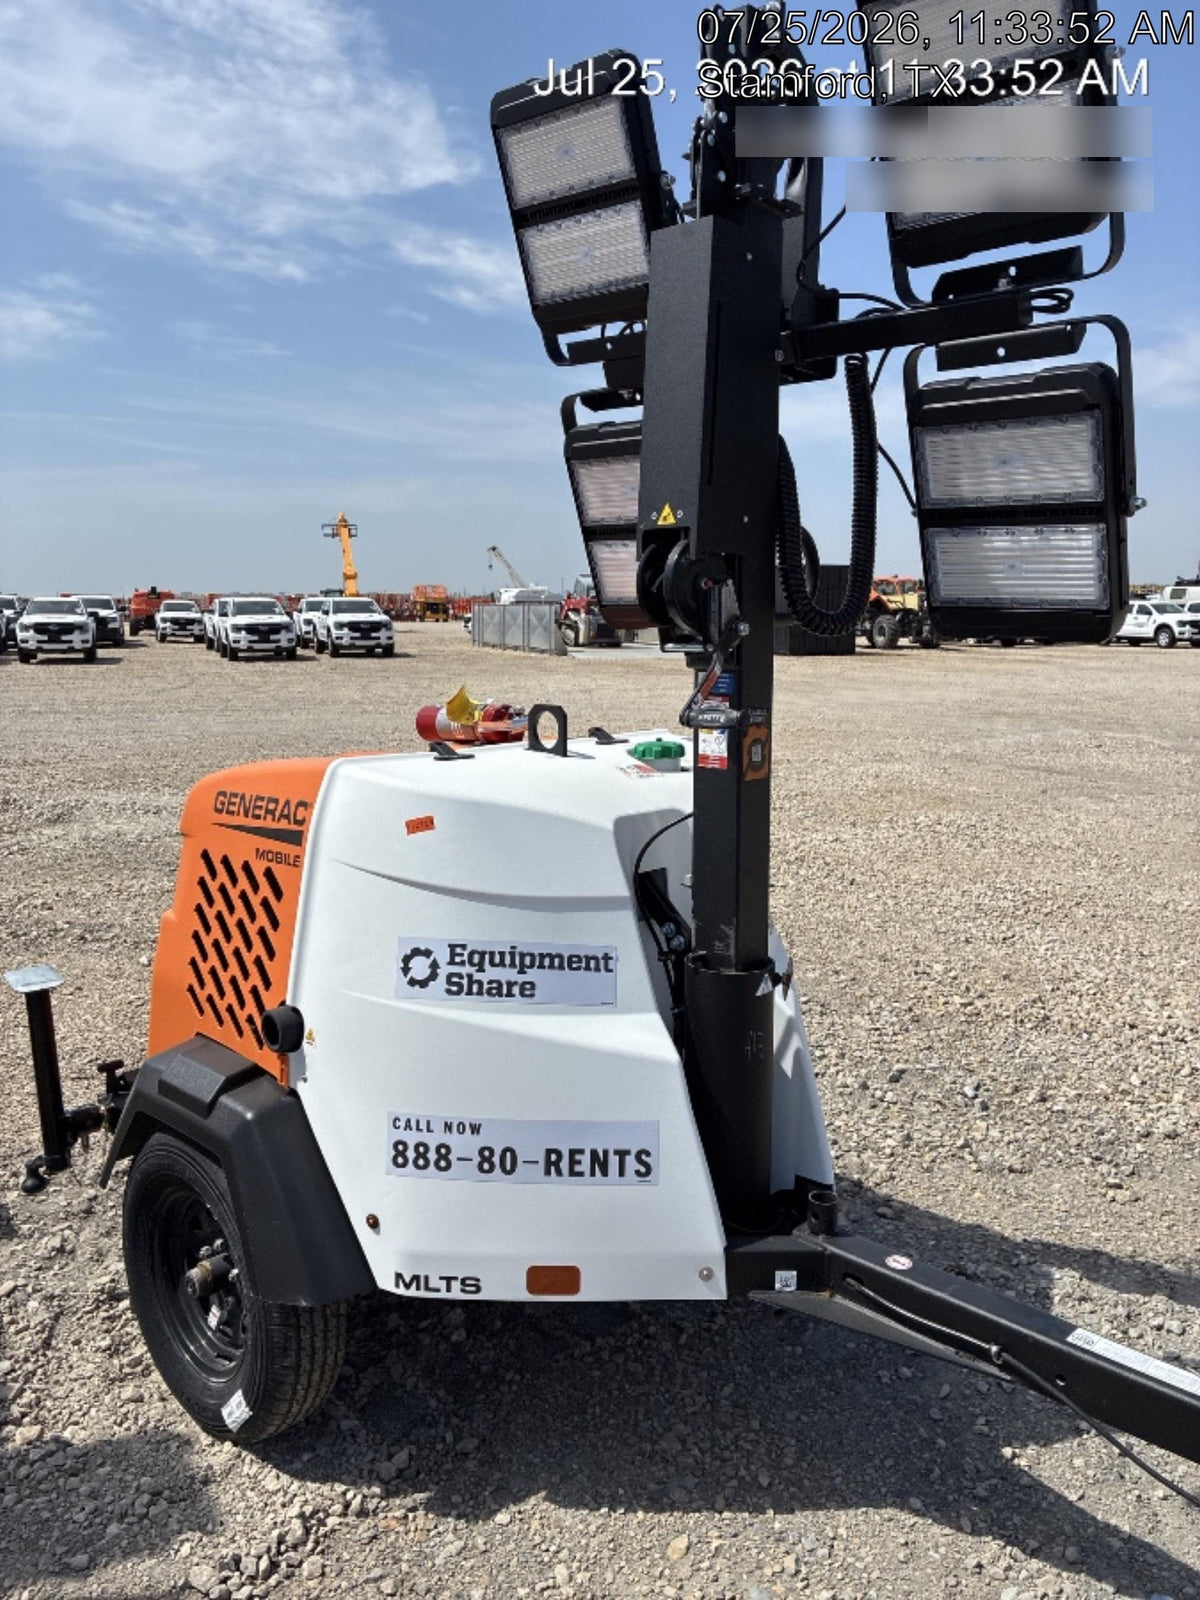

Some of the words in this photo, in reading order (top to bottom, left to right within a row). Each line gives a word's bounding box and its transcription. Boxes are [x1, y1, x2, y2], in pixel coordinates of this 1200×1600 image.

[213, 790, 309, 827] GENERAC
[255, 848, 301, 868] MOBILE
[446, 943, 614, 975] Equipment
[444, 971, 536, 998] Share
[392, 1116, 435, 1134] CALL
[443, 1120, 483, 1136] NOW
[391, 1139, 653, 1178] 888-80-RENTS
[394, 1272, 482, 1294] MLTS
